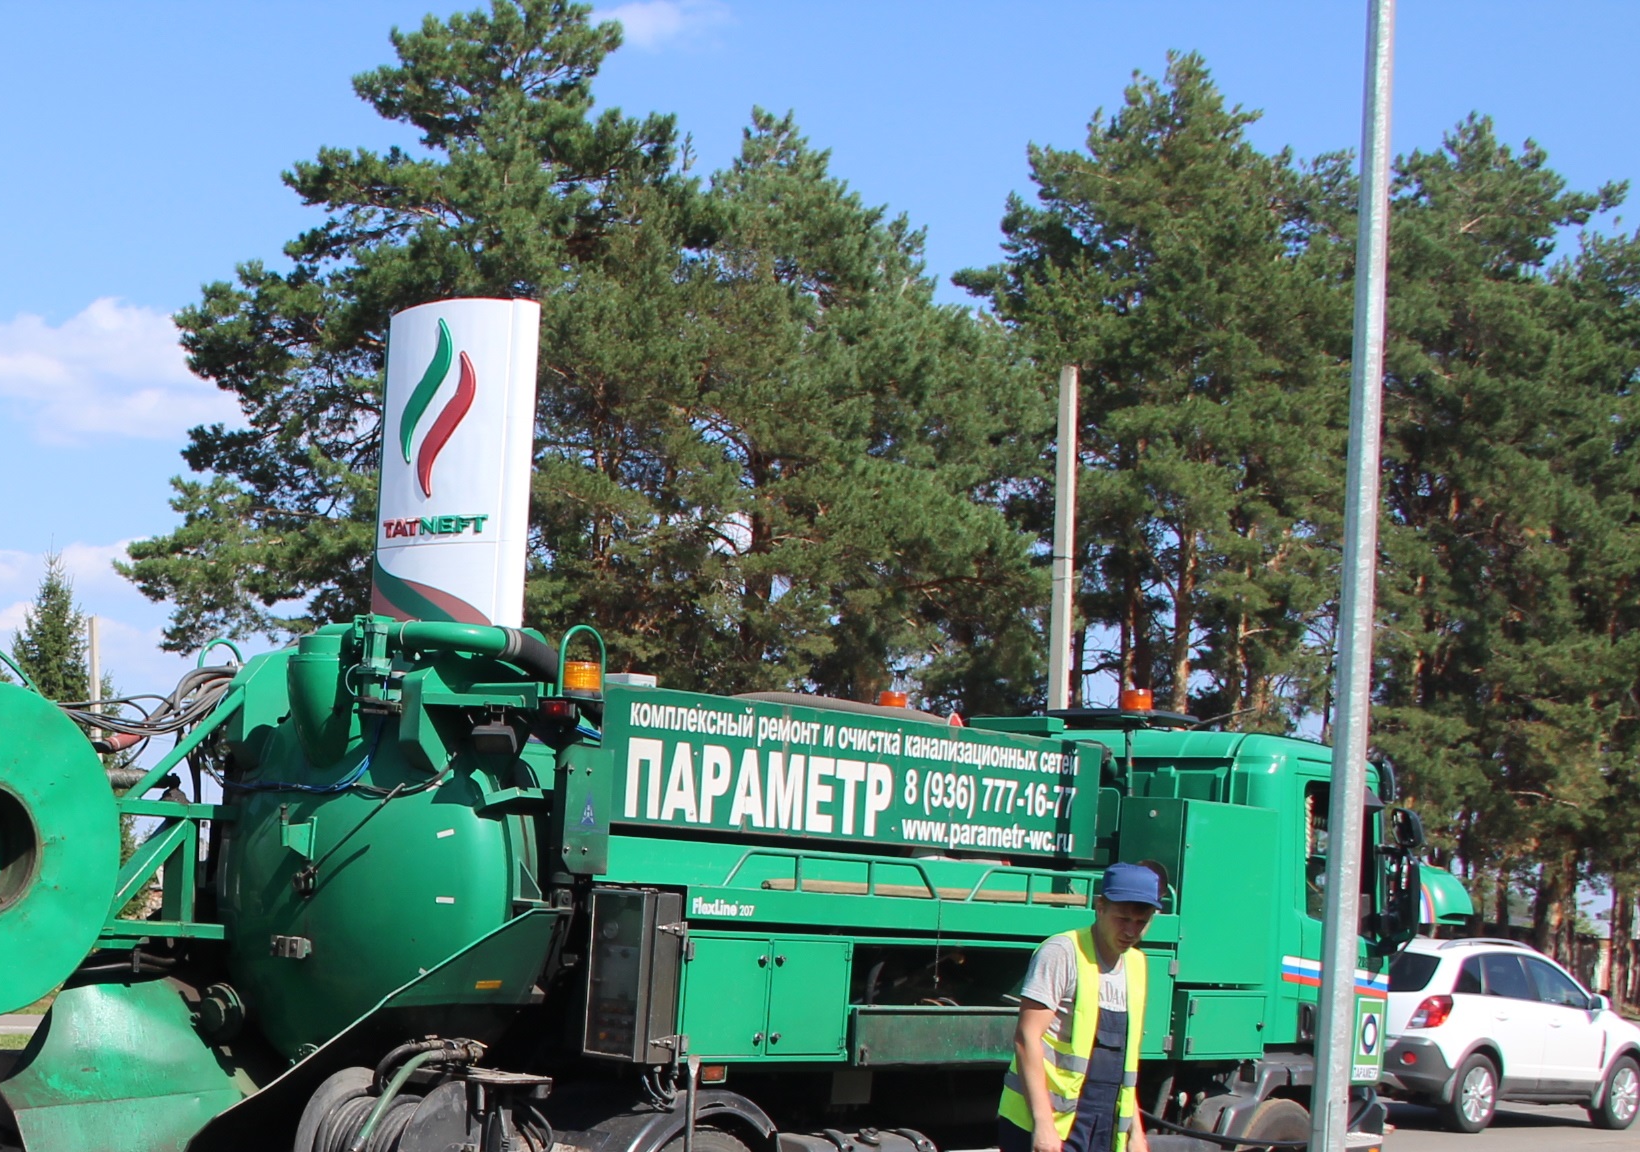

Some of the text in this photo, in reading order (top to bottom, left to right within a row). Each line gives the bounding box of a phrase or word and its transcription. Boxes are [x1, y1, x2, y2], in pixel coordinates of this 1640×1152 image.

[383, 514, 489, 539] TATNEFT
[629, 701, 1079, 776] комплексный ремонт и очистка канализационных сетей
[624, 736, 892, 837] ПАРАМЕТР
[903, 767, 1077, 819] 8 (936) 777-16-77
[901, 818, 1074, 853] www.parametr-wc.ru
[739, 905, 755, 917] 207
